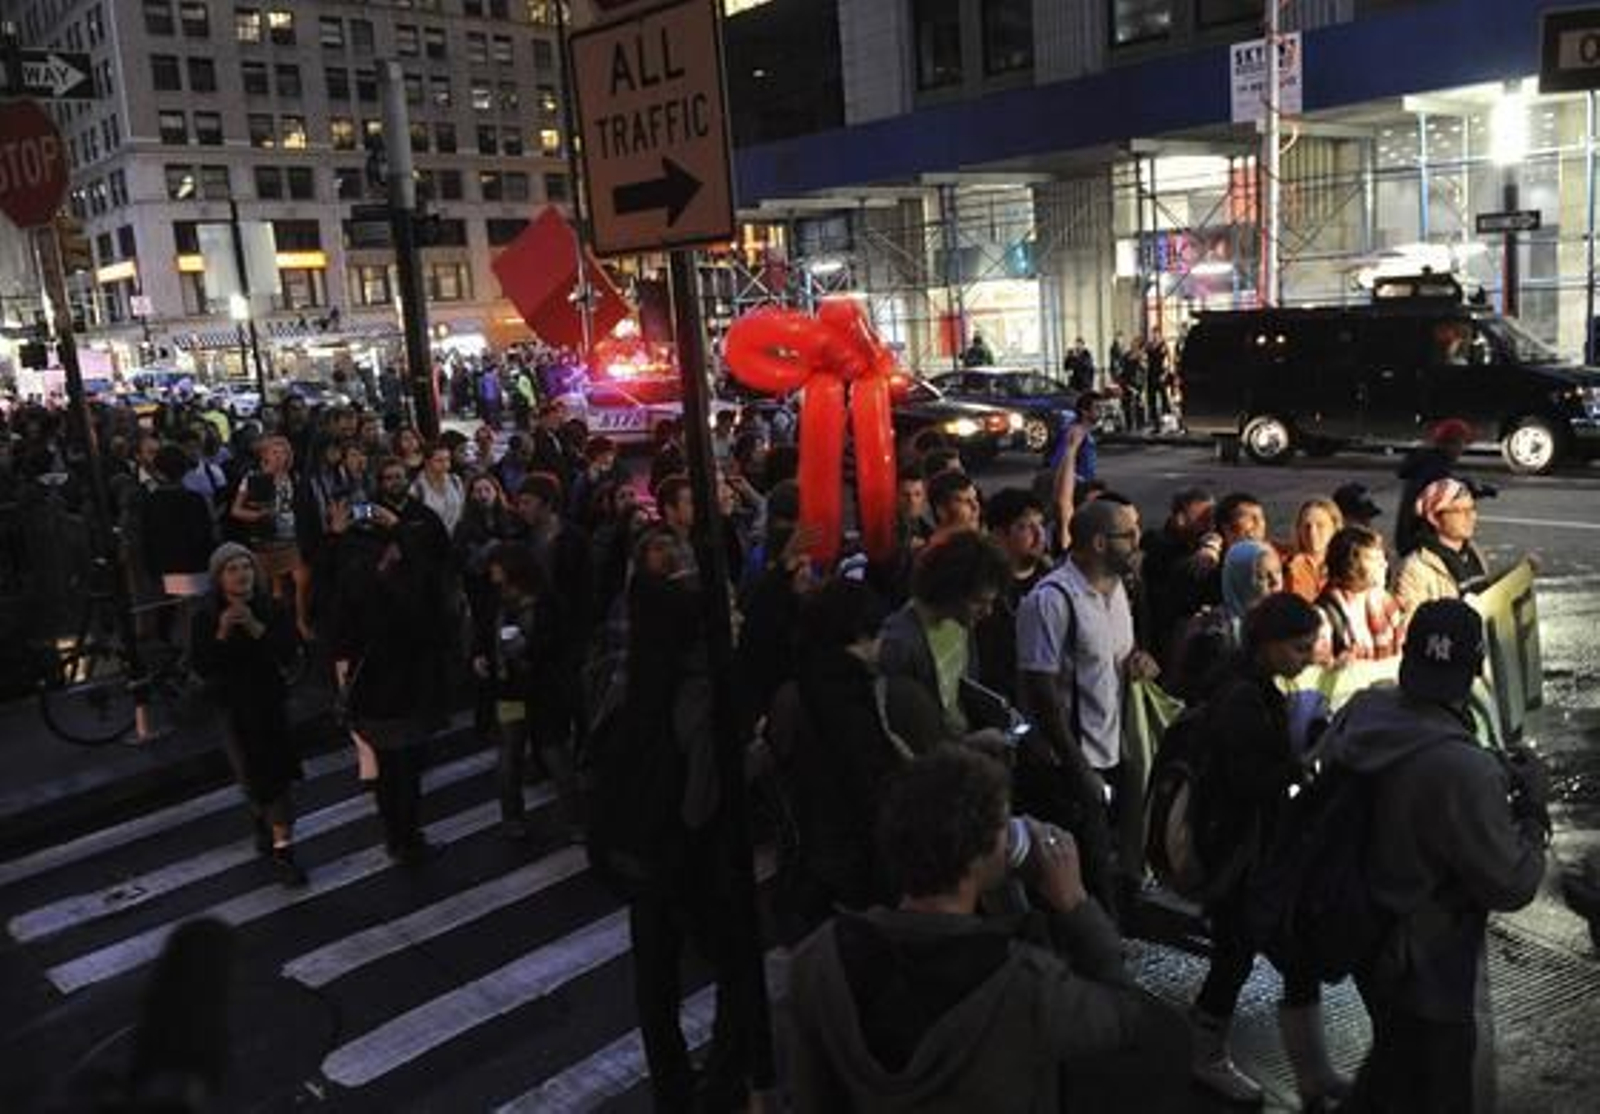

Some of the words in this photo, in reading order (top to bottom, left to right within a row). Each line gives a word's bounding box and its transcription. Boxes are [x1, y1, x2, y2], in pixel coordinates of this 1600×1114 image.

[24, 66, 68, 85] WAY
[611, 27, 685, 95] ALL
[595, 93, 708, 159] TRAFFIC
